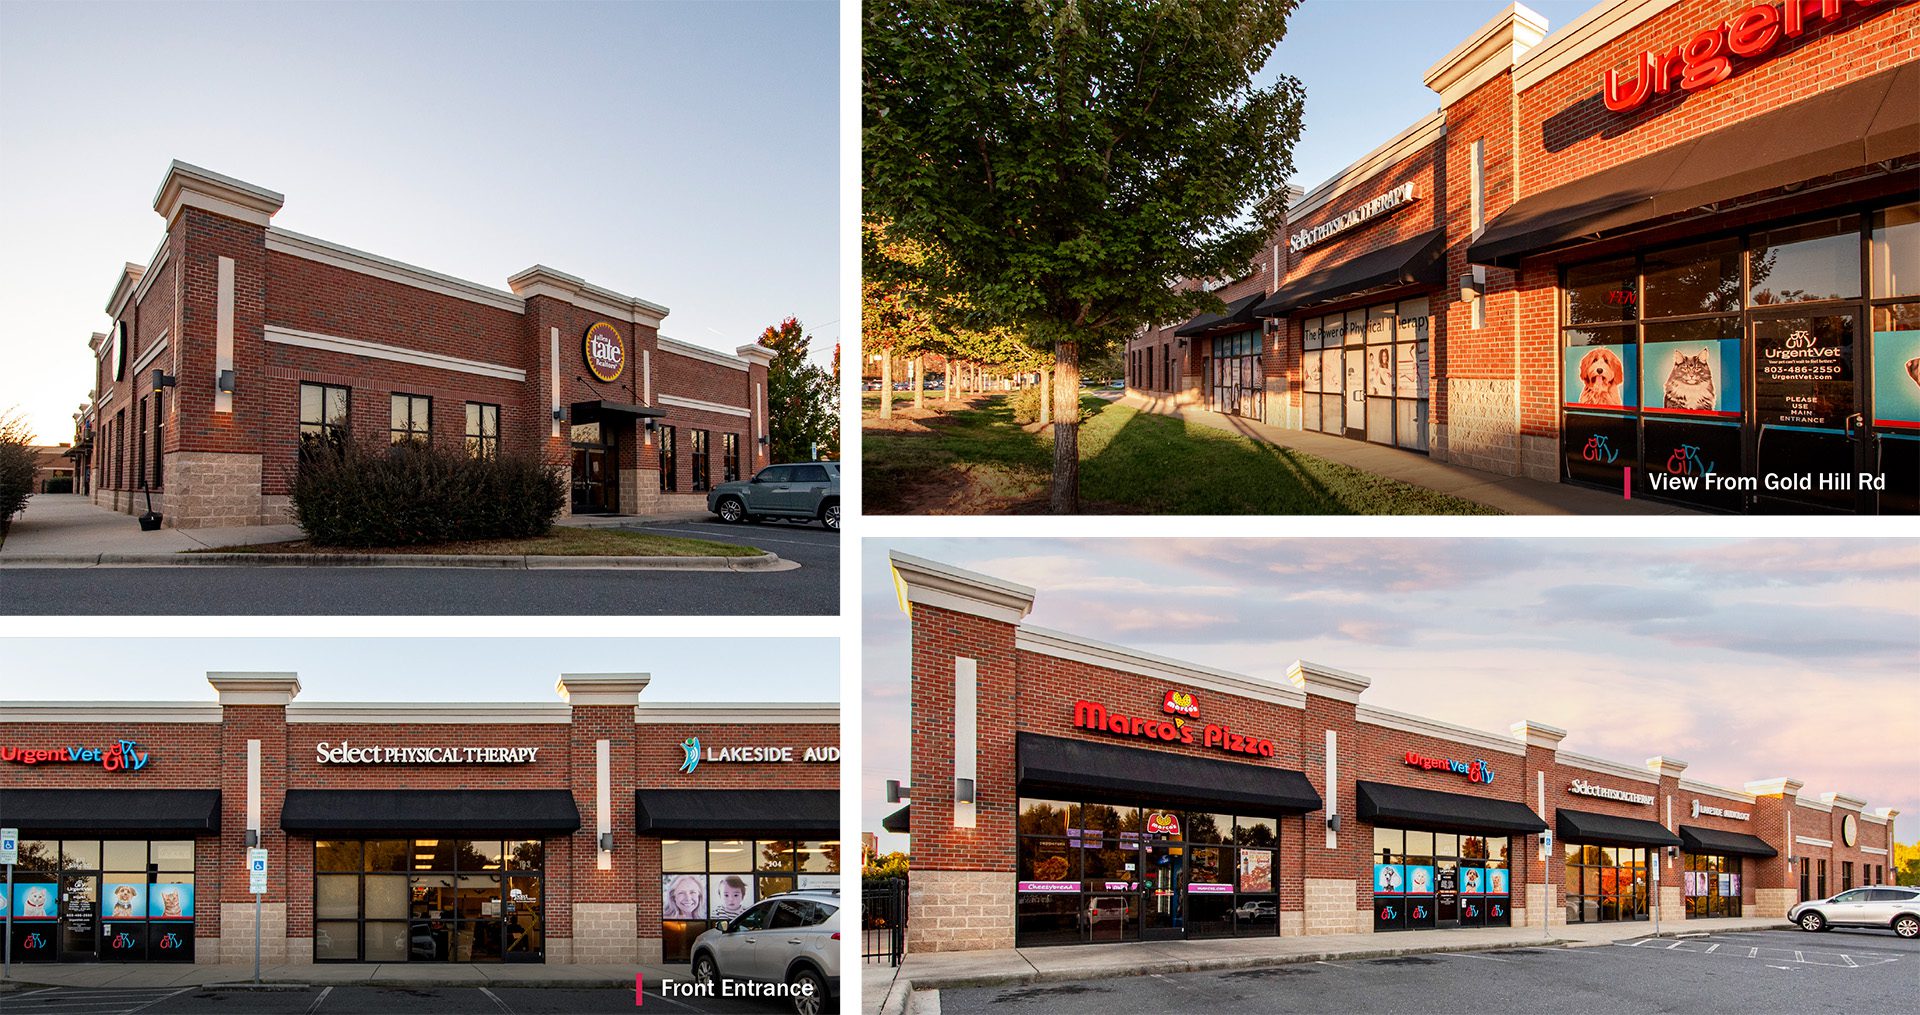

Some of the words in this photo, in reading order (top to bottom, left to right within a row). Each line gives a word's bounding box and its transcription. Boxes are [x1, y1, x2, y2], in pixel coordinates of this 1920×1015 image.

[1604, 0, 1880, 112] Urgen
[1290, 226, 1318, 253] Select
[1318, 210, 1360, 241] PHYSICAL
[1359, 181, 1415, 221] THERAPY
[1304, 329, 1316, 341] The
[1350, 316, 1385, 338] Phyical
[590, 334, 621, 363] tate
[1765, 347, 1841, 359] UrgentVet
[1203, 723, 1275, 757] Pizza
[1, 746, 103, 764] UrgentVet
[316, 741, 382, 763] Select
[384, 747, 463, 763] PHYSICAL
[463, 747, 539, 763] THERAPY
[706, 747, 793, 762] LAKESIDE
[803, 747, 840, 762] AUD
[1405, 751, 1470, 774] UrgentVet
[1571, 779, 1600, 797] Select
